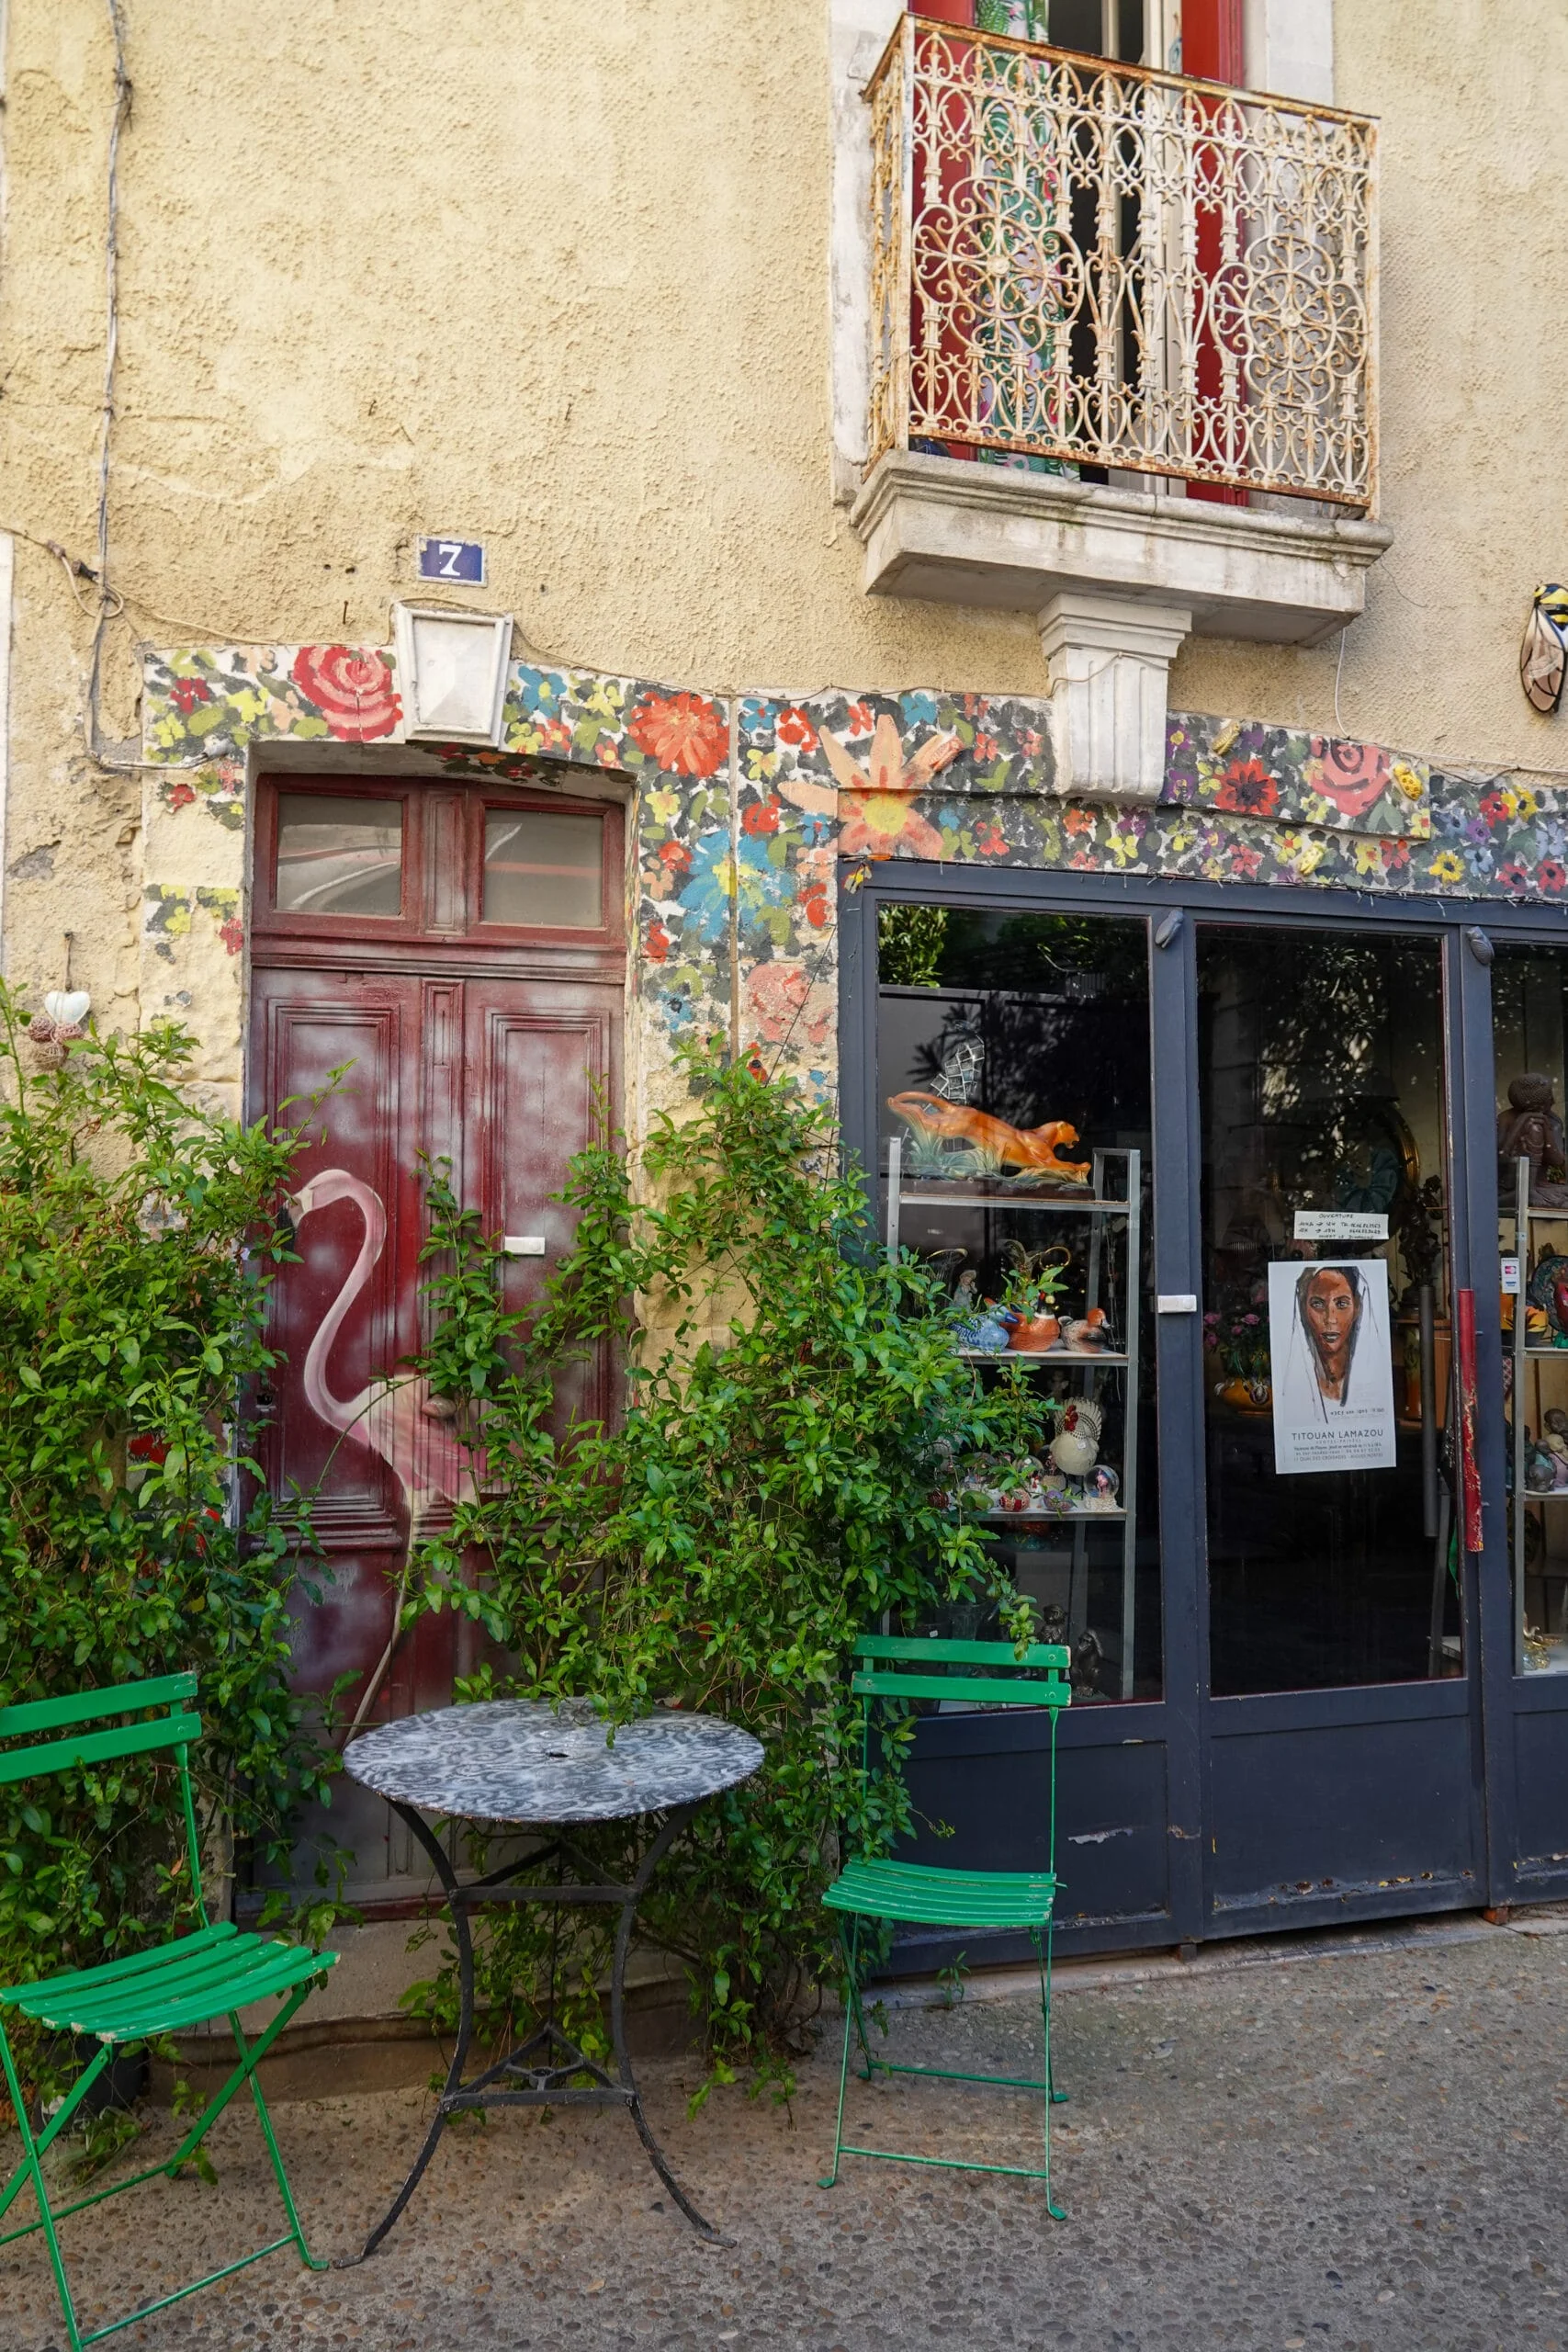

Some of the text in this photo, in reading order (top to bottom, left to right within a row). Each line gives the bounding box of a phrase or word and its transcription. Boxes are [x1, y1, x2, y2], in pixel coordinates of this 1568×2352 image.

[438, 543, 462, 576] 7
[1292, 1430, 1383, 1441] TITOUAN LAMAZOU
